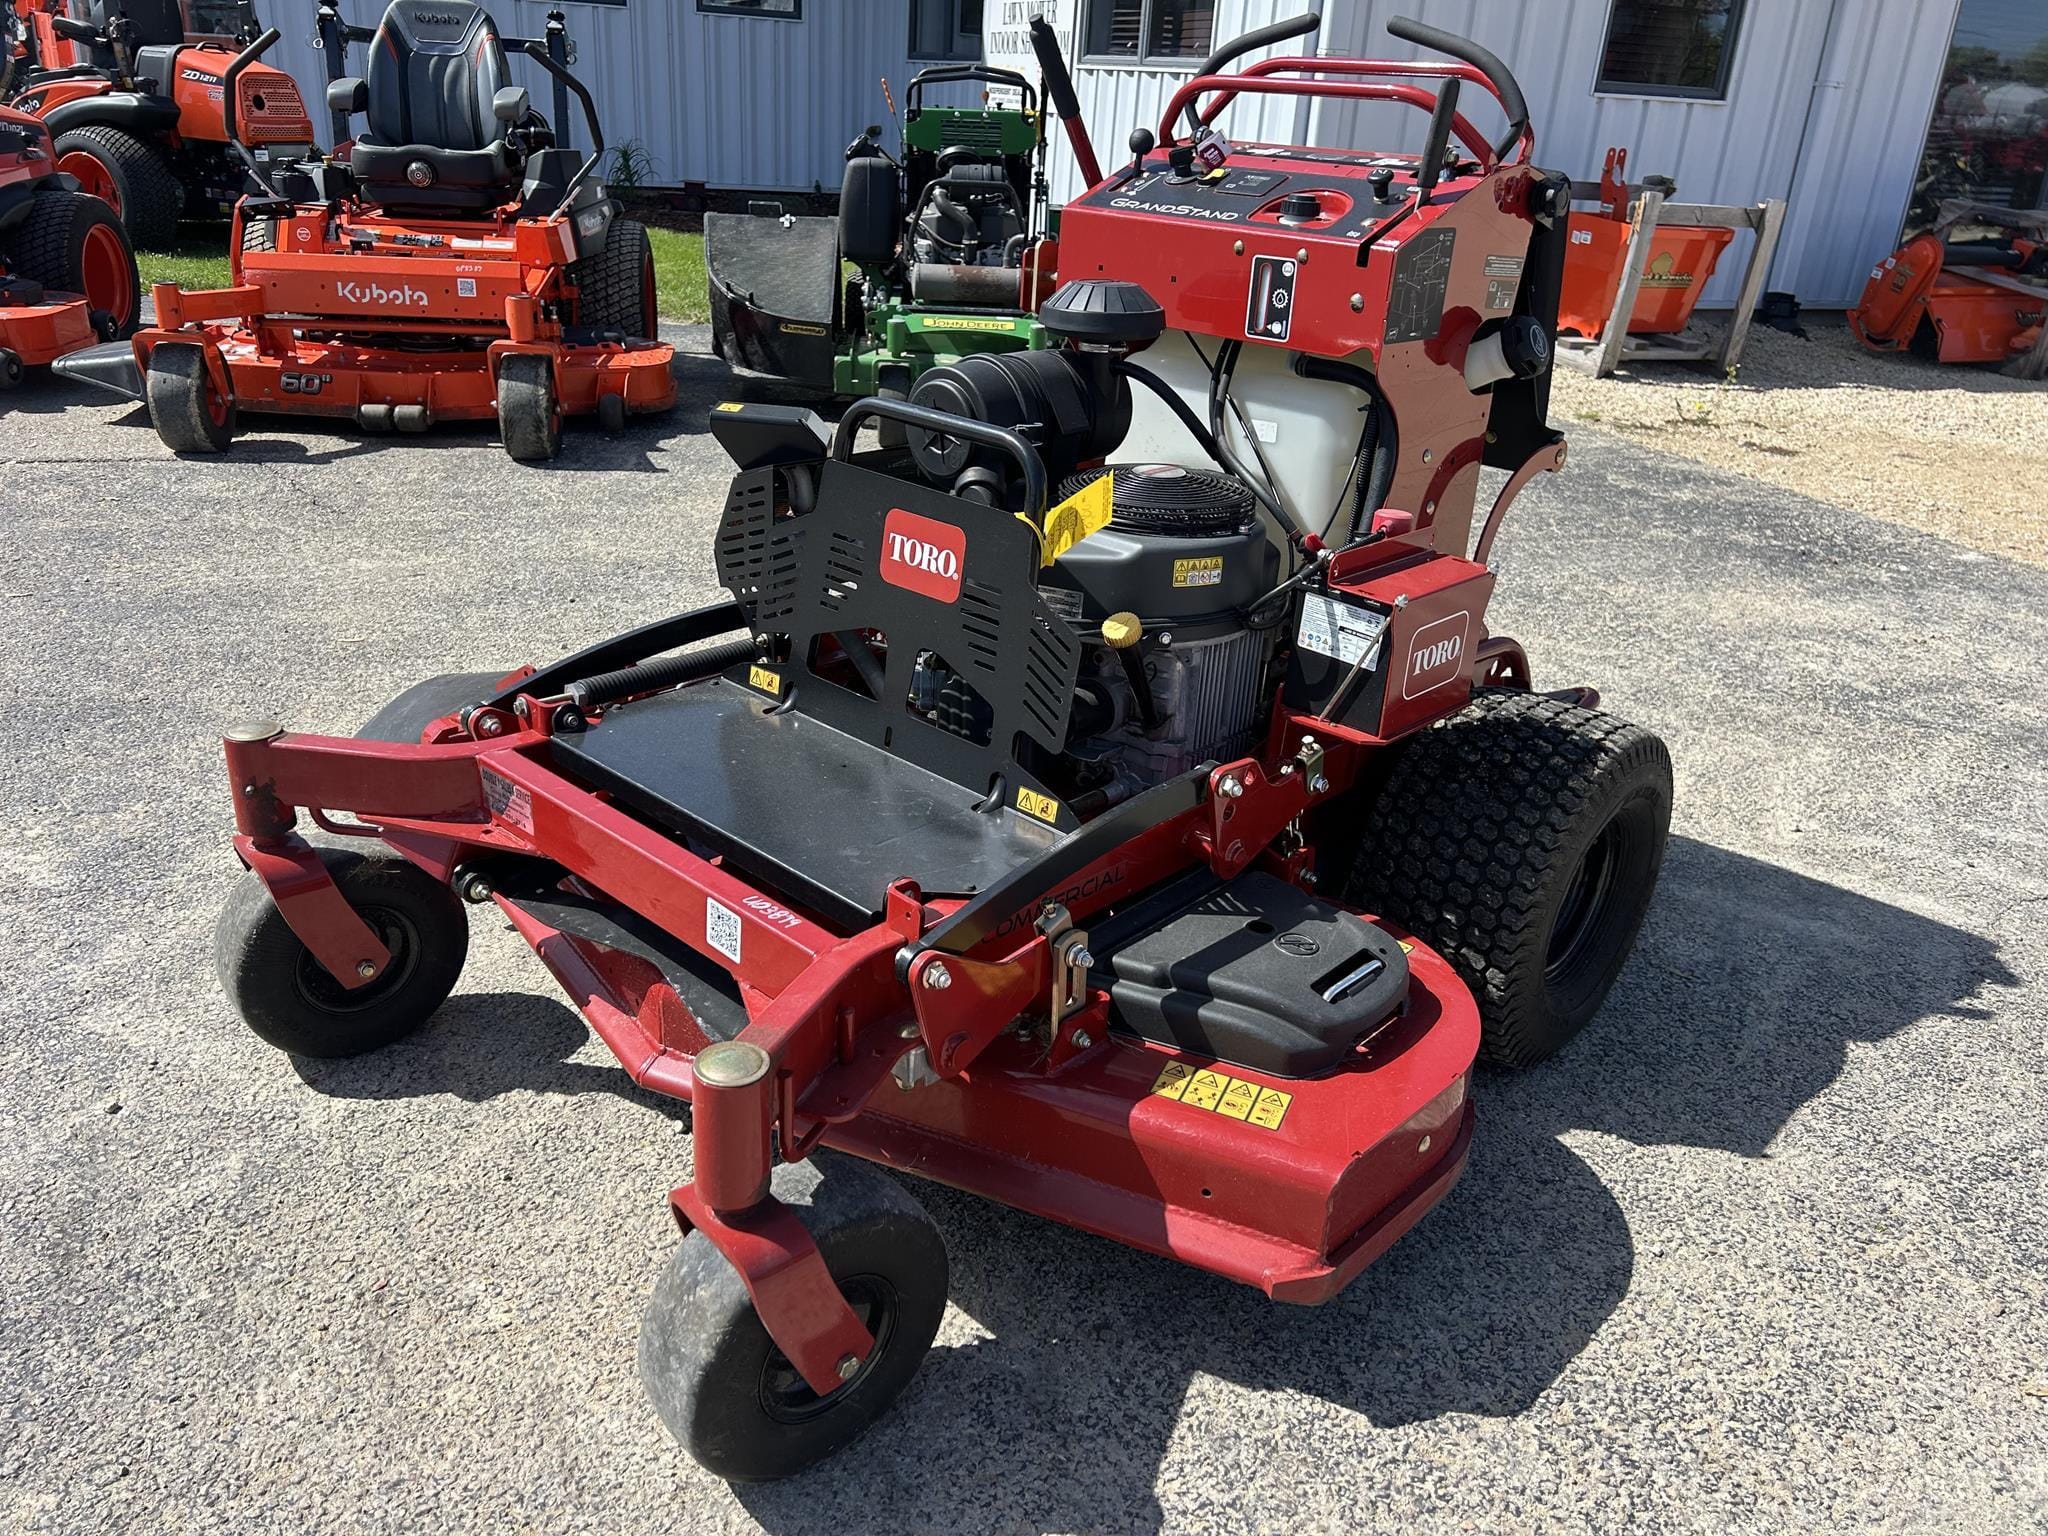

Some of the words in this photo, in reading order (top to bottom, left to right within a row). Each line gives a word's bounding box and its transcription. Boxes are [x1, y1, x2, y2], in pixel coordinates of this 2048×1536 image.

[414, 12, 460, 25] Kubota
[989, 31, 1019, 54] INDOOR
[1110, 198, 1239, 220] GRANDSTAND
[336, 281, 429, 306] Kubota
[932, 319, 964, 329] JOHN
[966, 321, 1008, 330] DEERE
[281, 372, 332, 395] 60"
[889, 532, 957, 578] TORO
[1412, 634, 1461, 677] TORO
